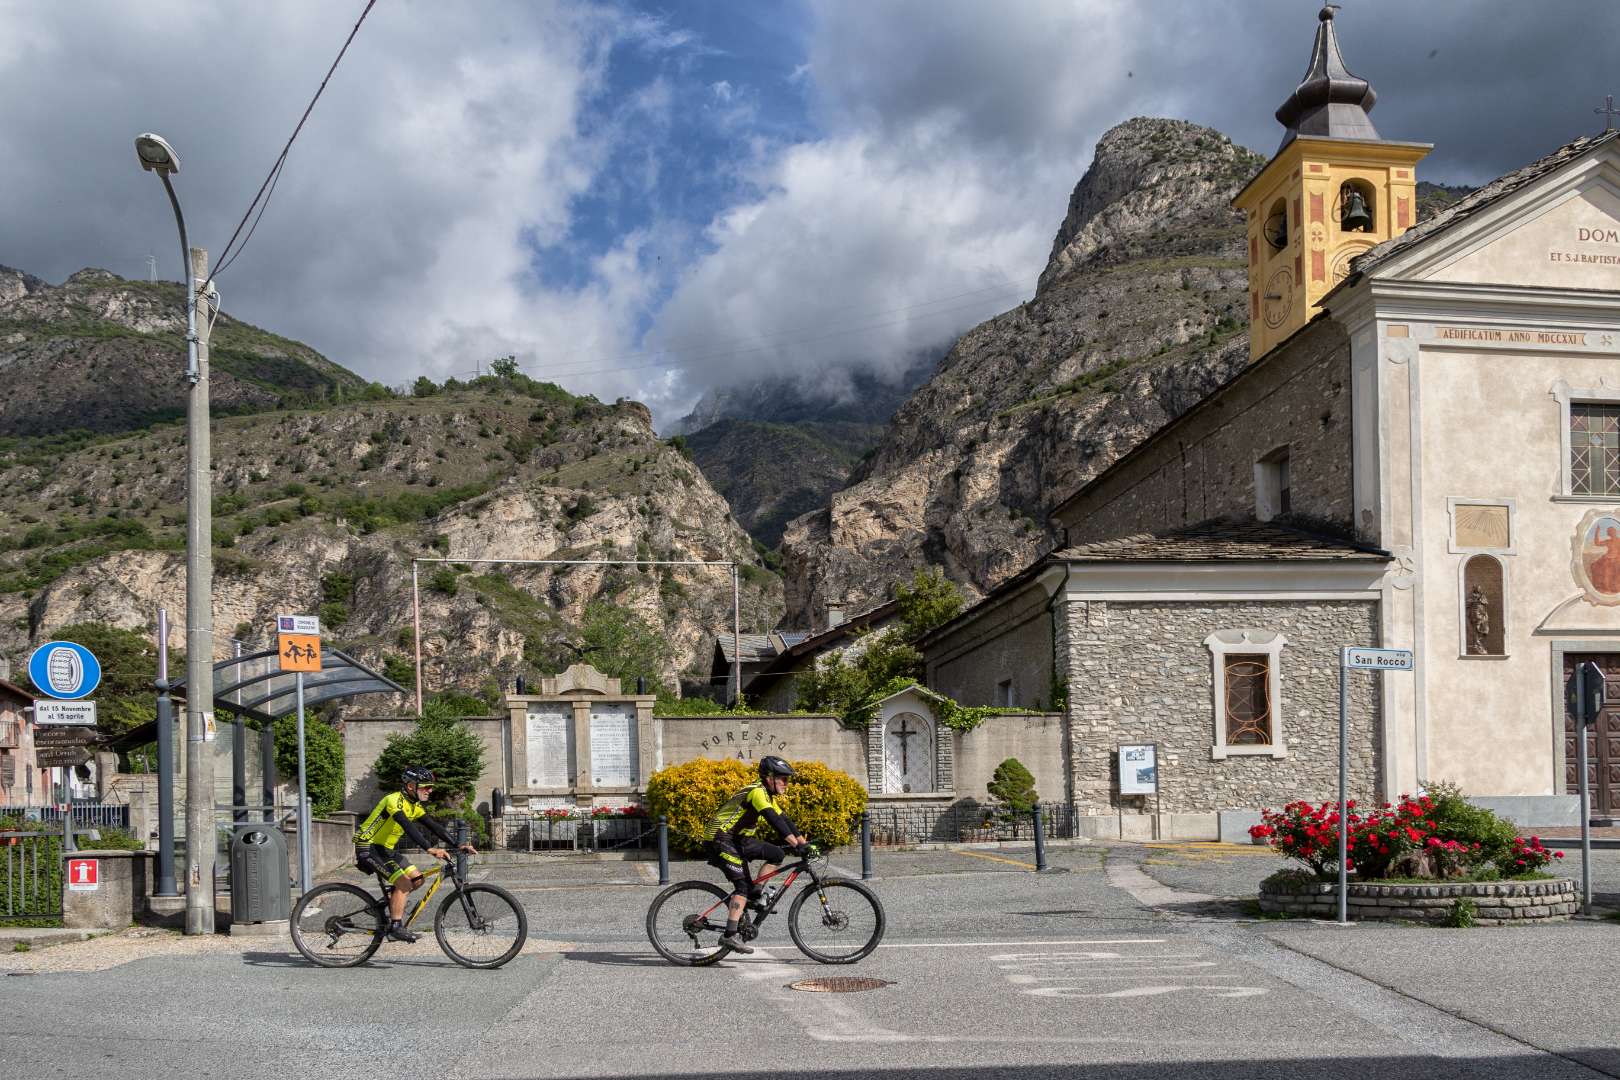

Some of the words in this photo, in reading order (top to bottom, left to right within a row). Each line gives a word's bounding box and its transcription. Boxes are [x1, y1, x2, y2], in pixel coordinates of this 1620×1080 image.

[1579, 228, 1619, 243] DOM
[1550, 252, 1562, 262] ET
[1443, 330, 1502, 341] AEDIFICATUM
[1508, 331, 1531, 342] ANNO
[1538, 333, 1577, 345] MDCCXXI
[1355, 655, 1372, 665] San
[1377, 656, 1406, 666] Rocco
[702, 730, 787, 751] FORESTO
[736, 749, 753, 759] AI
